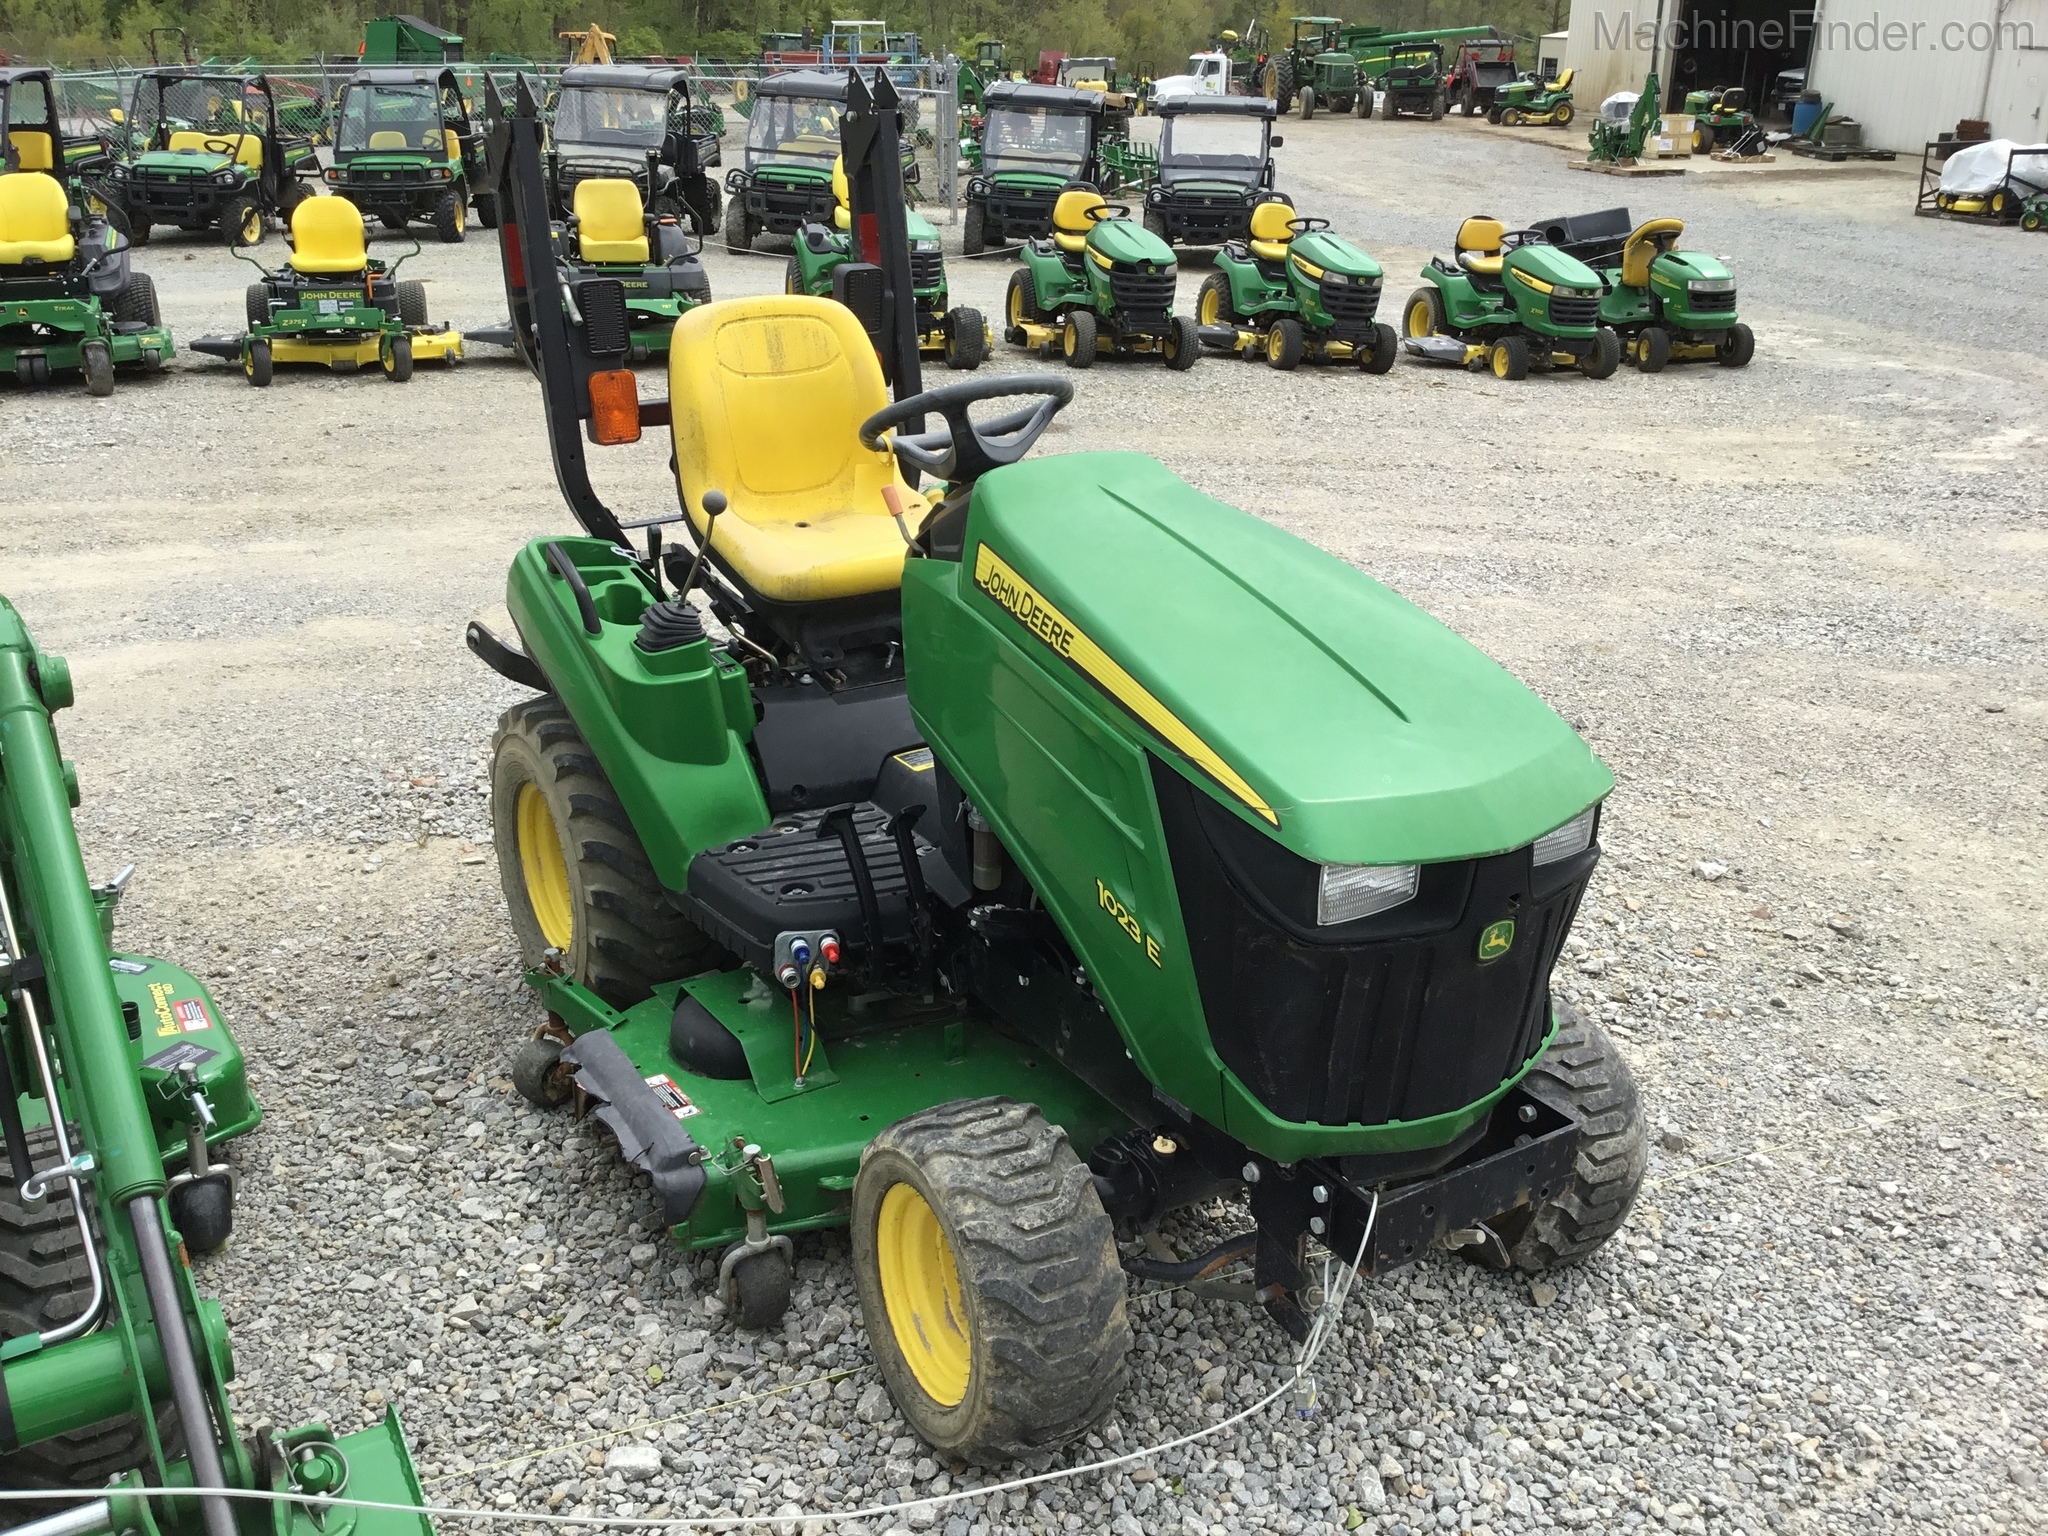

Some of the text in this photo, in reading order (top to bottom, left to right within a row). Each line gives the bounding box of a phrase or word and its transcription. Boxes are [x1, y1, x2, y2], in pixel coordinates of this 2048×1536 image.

[301, 291, 361, 300] JOHN DEERE
[982, 565, 1074, 655] JOHN DEERE
[1096, 877, 1161, 969] 1023 E
